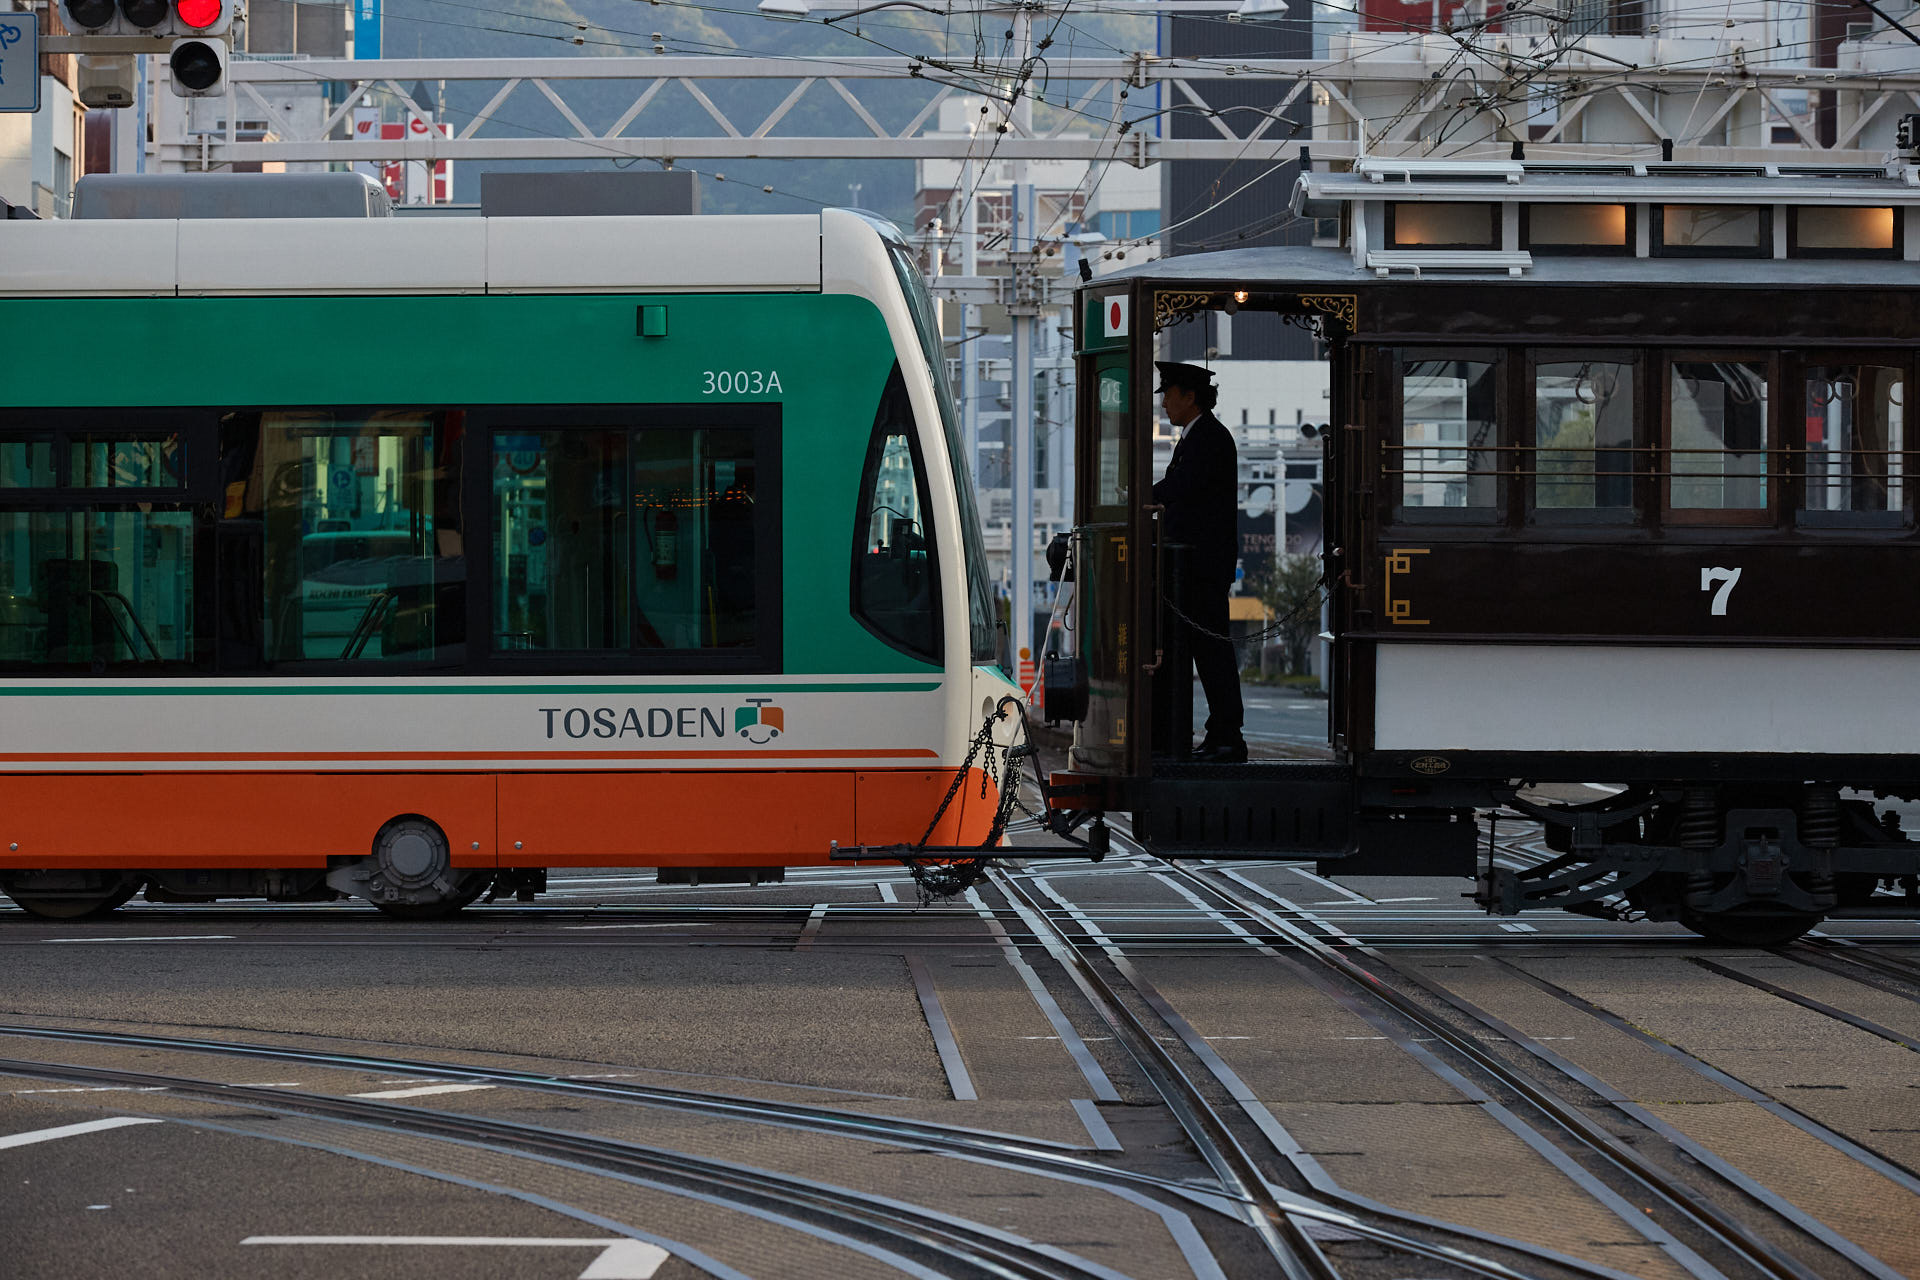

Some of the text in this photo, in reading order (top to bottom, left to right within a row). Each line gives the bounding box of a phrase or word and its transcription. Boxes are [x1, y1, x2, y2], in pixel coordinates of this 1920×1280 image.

[702, 370, 783, 394] 3003A
[1701, 566, 1742, 616] 7
[538, 707, 725, 739] TOSADEN
